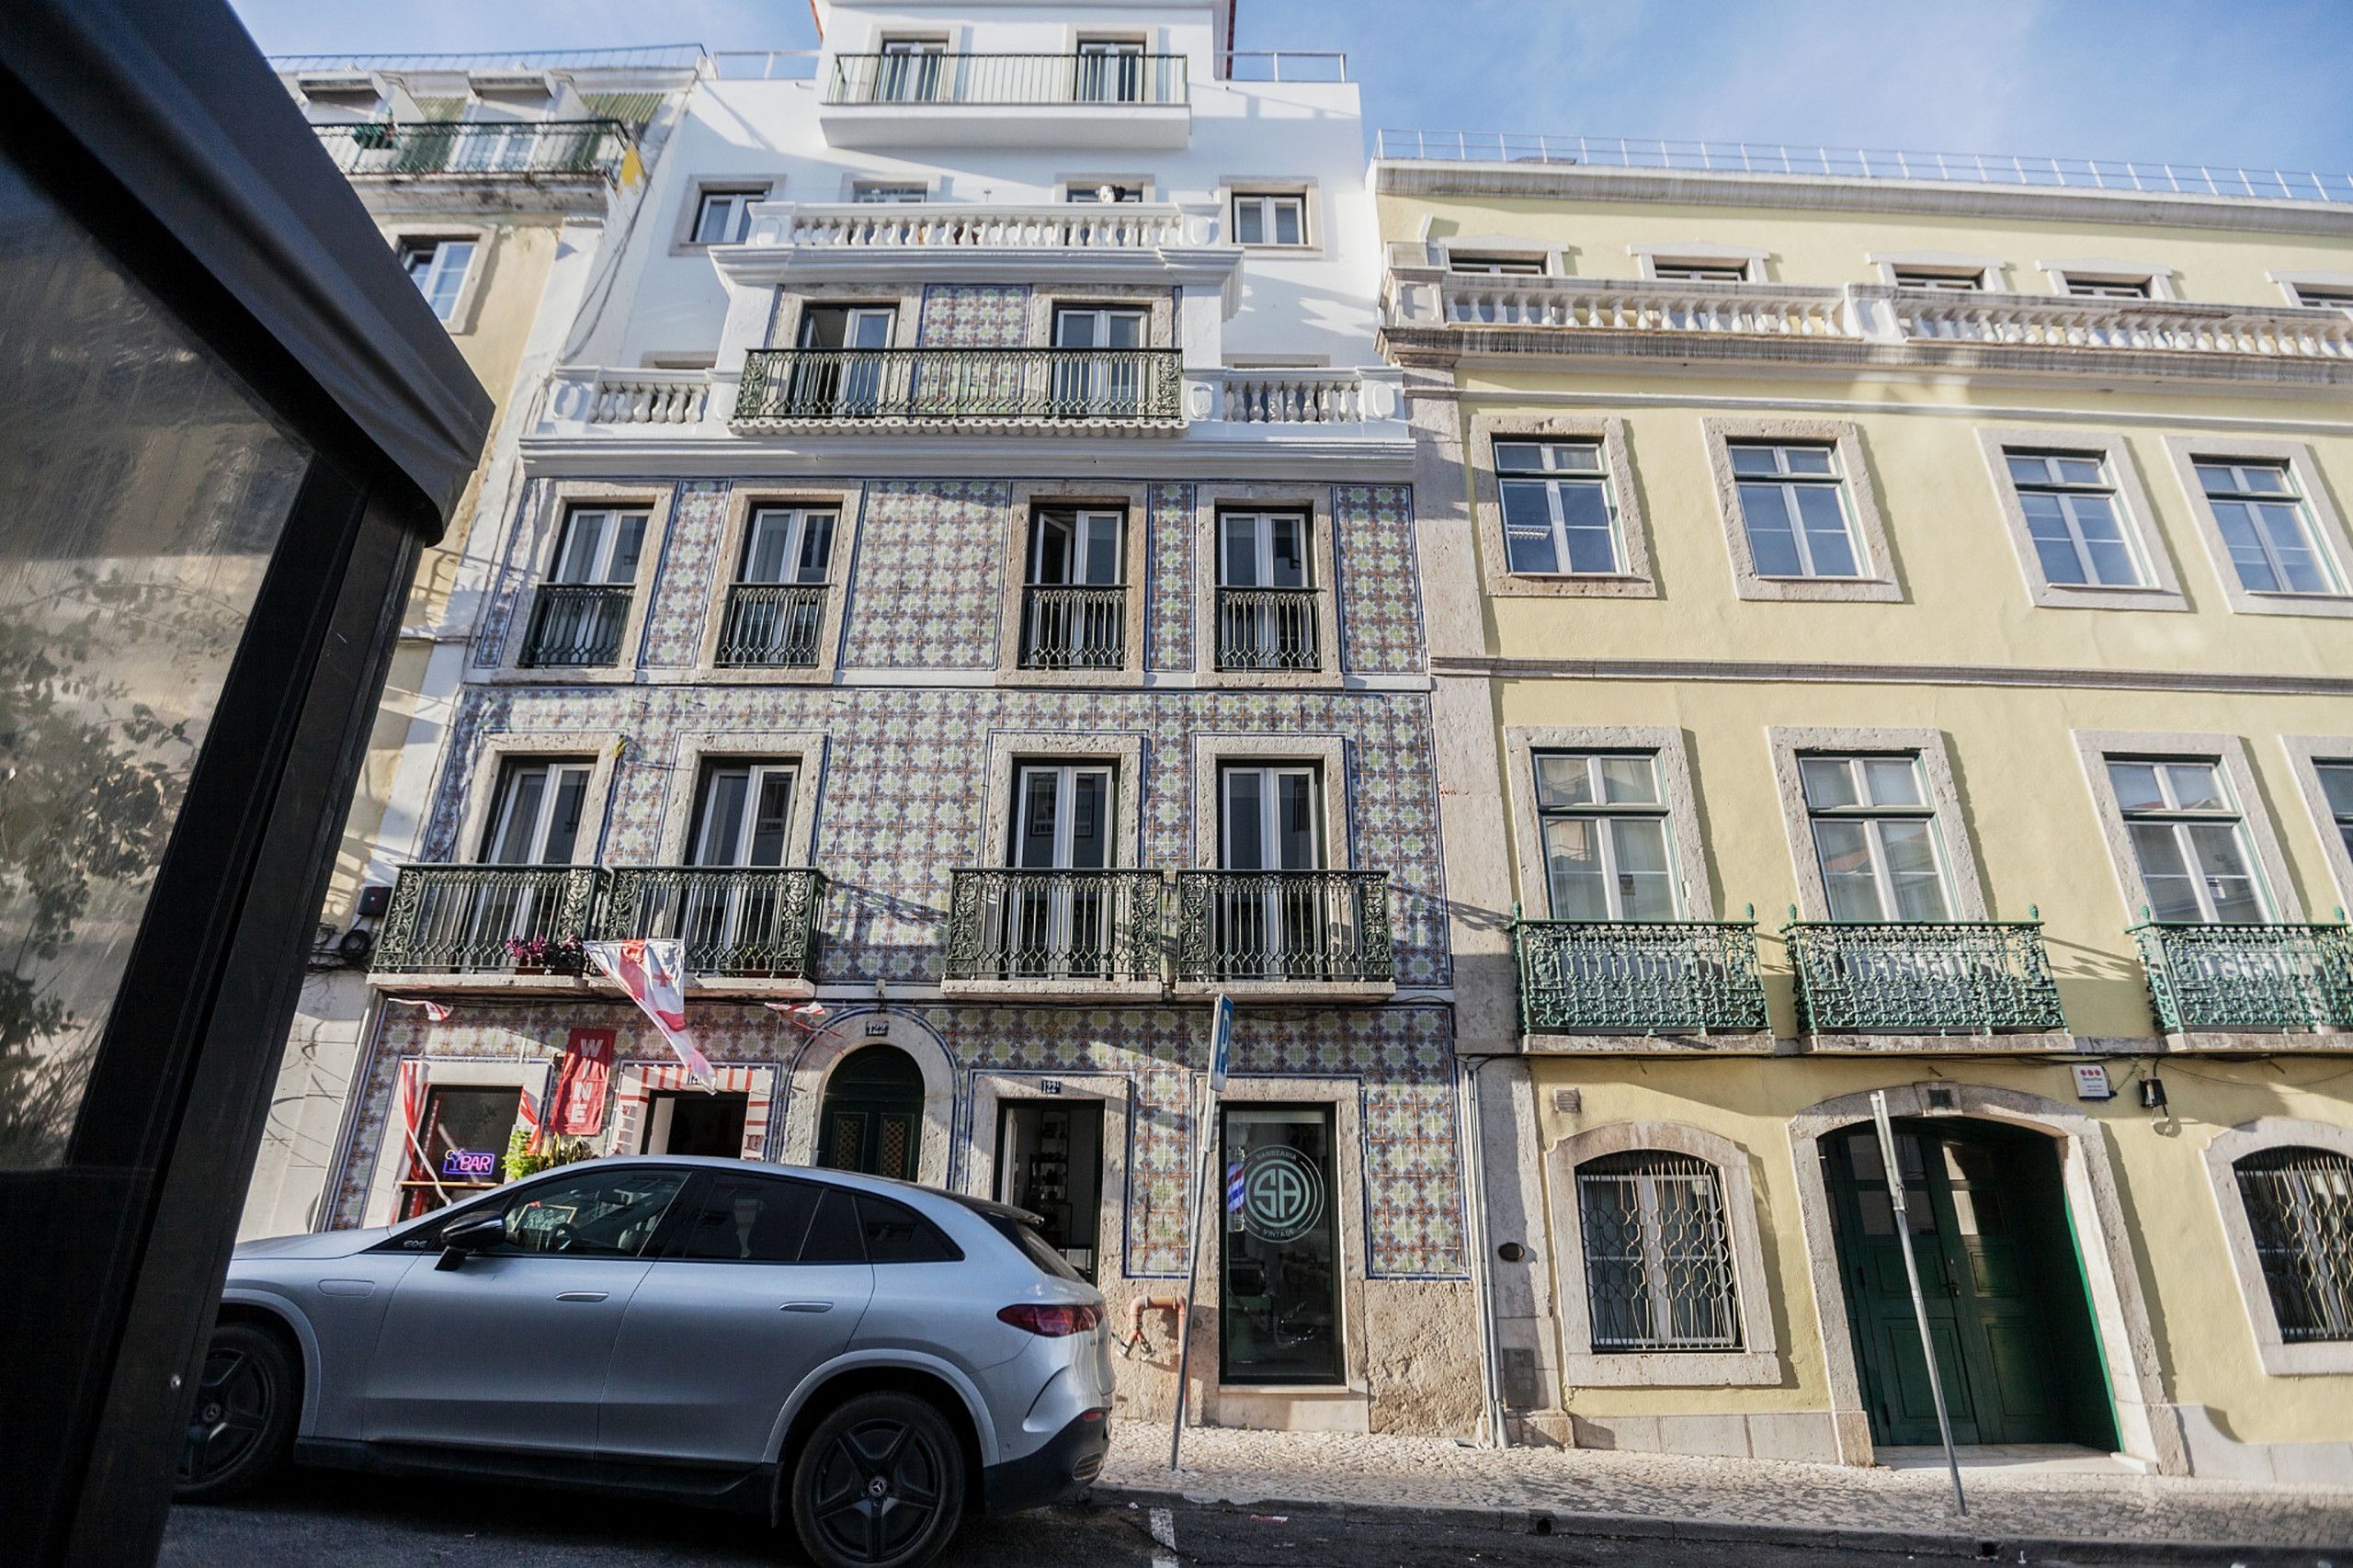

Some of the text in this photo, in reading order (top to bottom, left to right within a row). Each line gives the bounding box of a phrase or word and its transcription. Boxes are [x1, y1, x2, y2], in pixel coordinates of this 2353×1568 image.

[869, 1023, 886, 1035] 122
[570, 1039, 604, 1124] WINE
[460, 1154, 492, 1171] BAR
[1254, 1168, 1302, 1218] SA
[1263, 1227, 1296, 1238] VINTAGE
